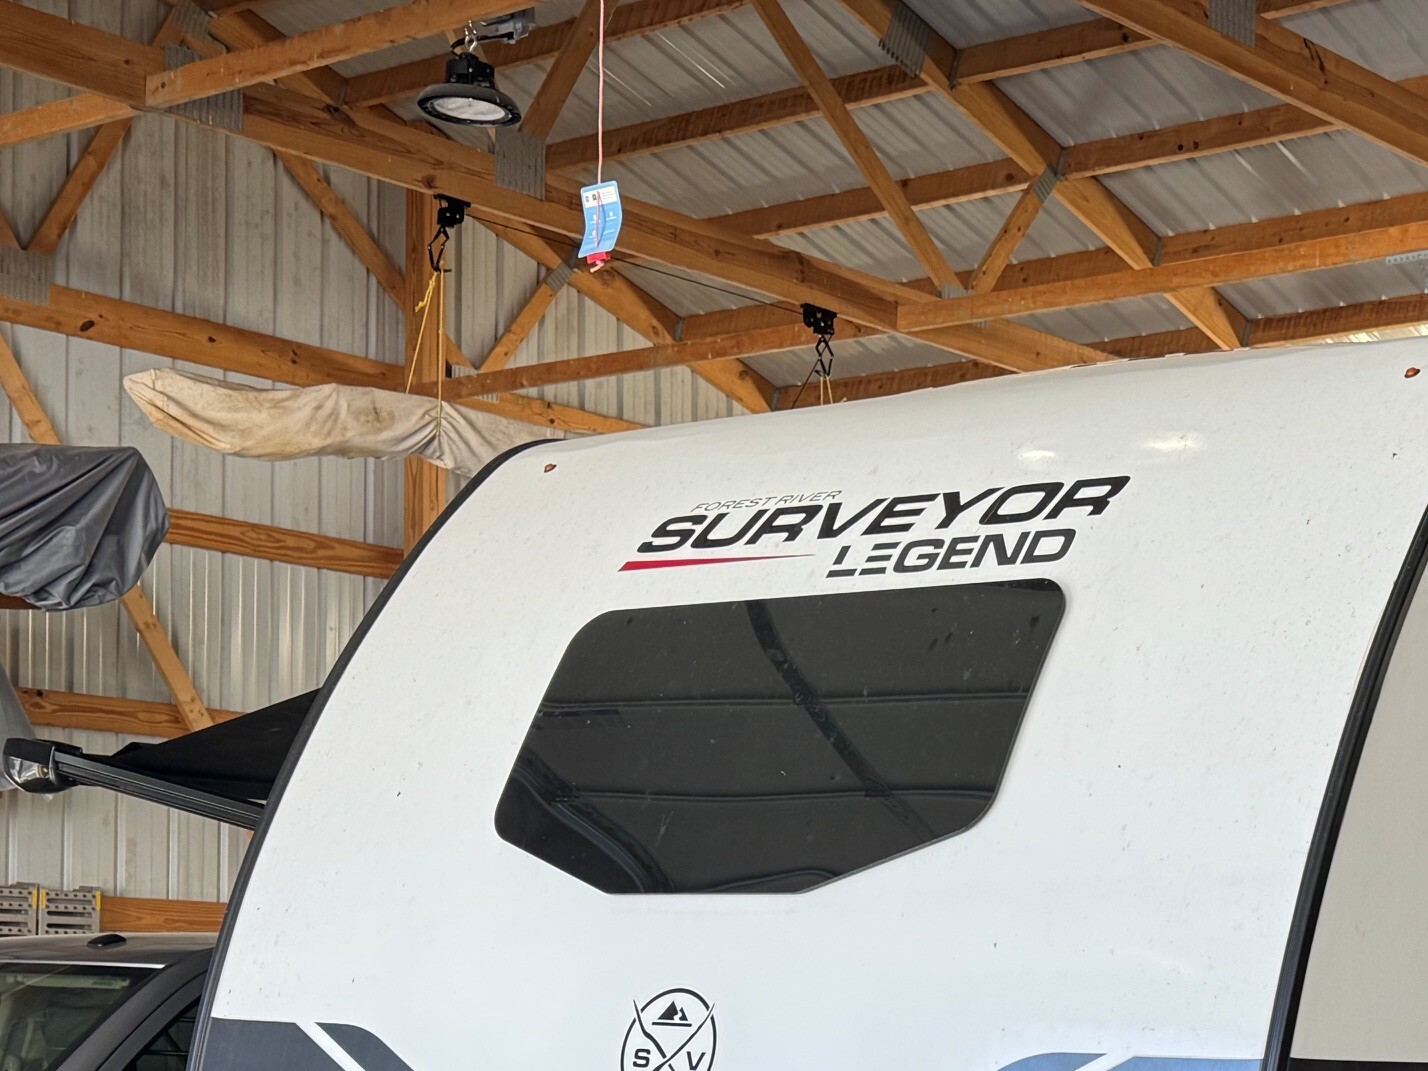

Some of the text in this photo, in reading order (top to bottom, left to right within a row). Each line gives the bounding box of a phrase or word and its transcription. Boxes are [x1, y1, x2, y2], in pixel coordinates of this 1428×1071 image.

[638, 475, 1131, 554] SURVEYOR
[690, 490, 843, 512] FOREST RIVER
[826, 528, 1077, 579] LEGEND
[632, 1048, 707, 1071] S V
